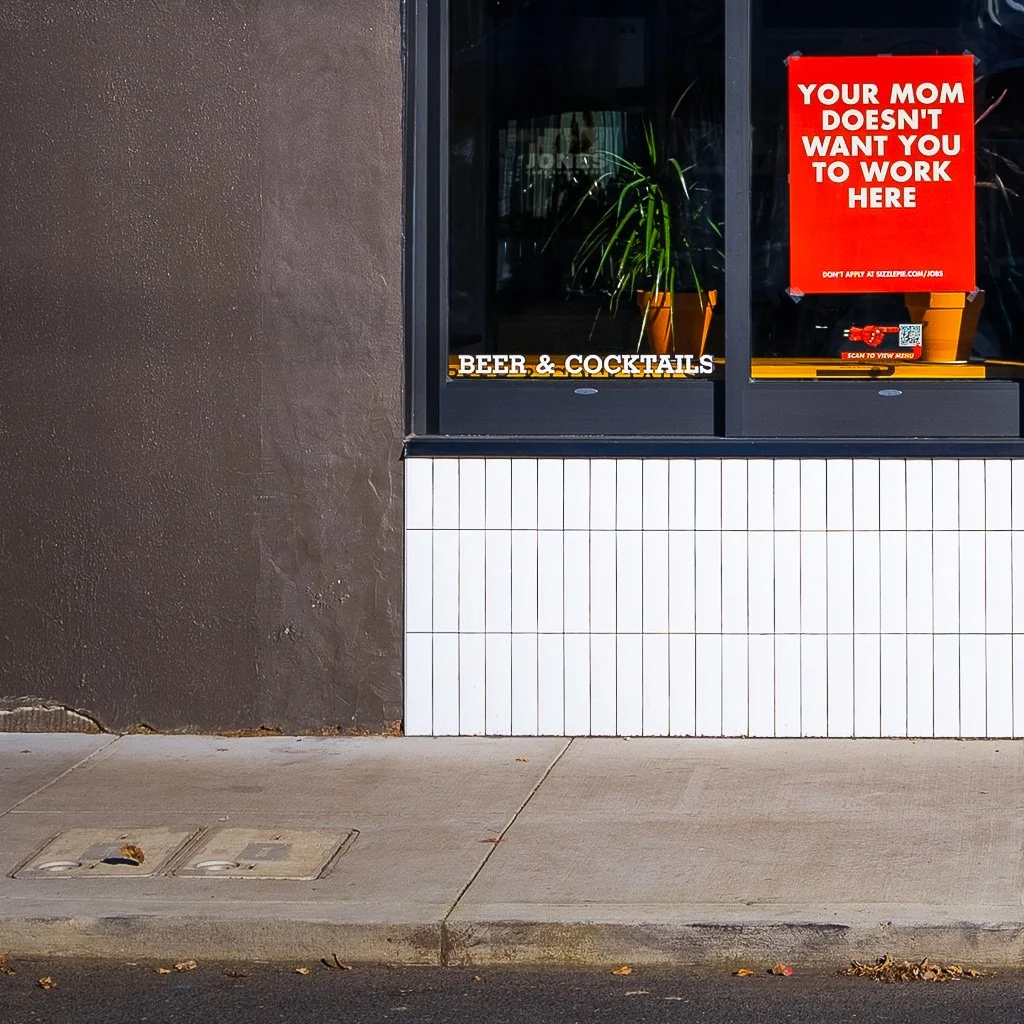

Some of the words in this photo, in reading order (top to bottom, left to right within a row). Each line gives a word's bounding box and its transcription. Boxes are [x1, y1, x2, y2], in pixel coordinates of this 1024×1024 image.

[797, 83, 879, 105] YOUR
[890, 82, 965, 104] MOM
[821, 109, 942, 131] DOESN'T
[801, 135, 888, 157] WANT
[898, 134, 961, 156] YOU
[812, 161, 850, 183] TO
[860, 160, 952, 183] WORK
[848, 187, 916, 209] HERE
[458, 354, 527, 374] BEER
[535, 354, 555, 374] &
[564, 354, 714, 374] COCKTAILS
